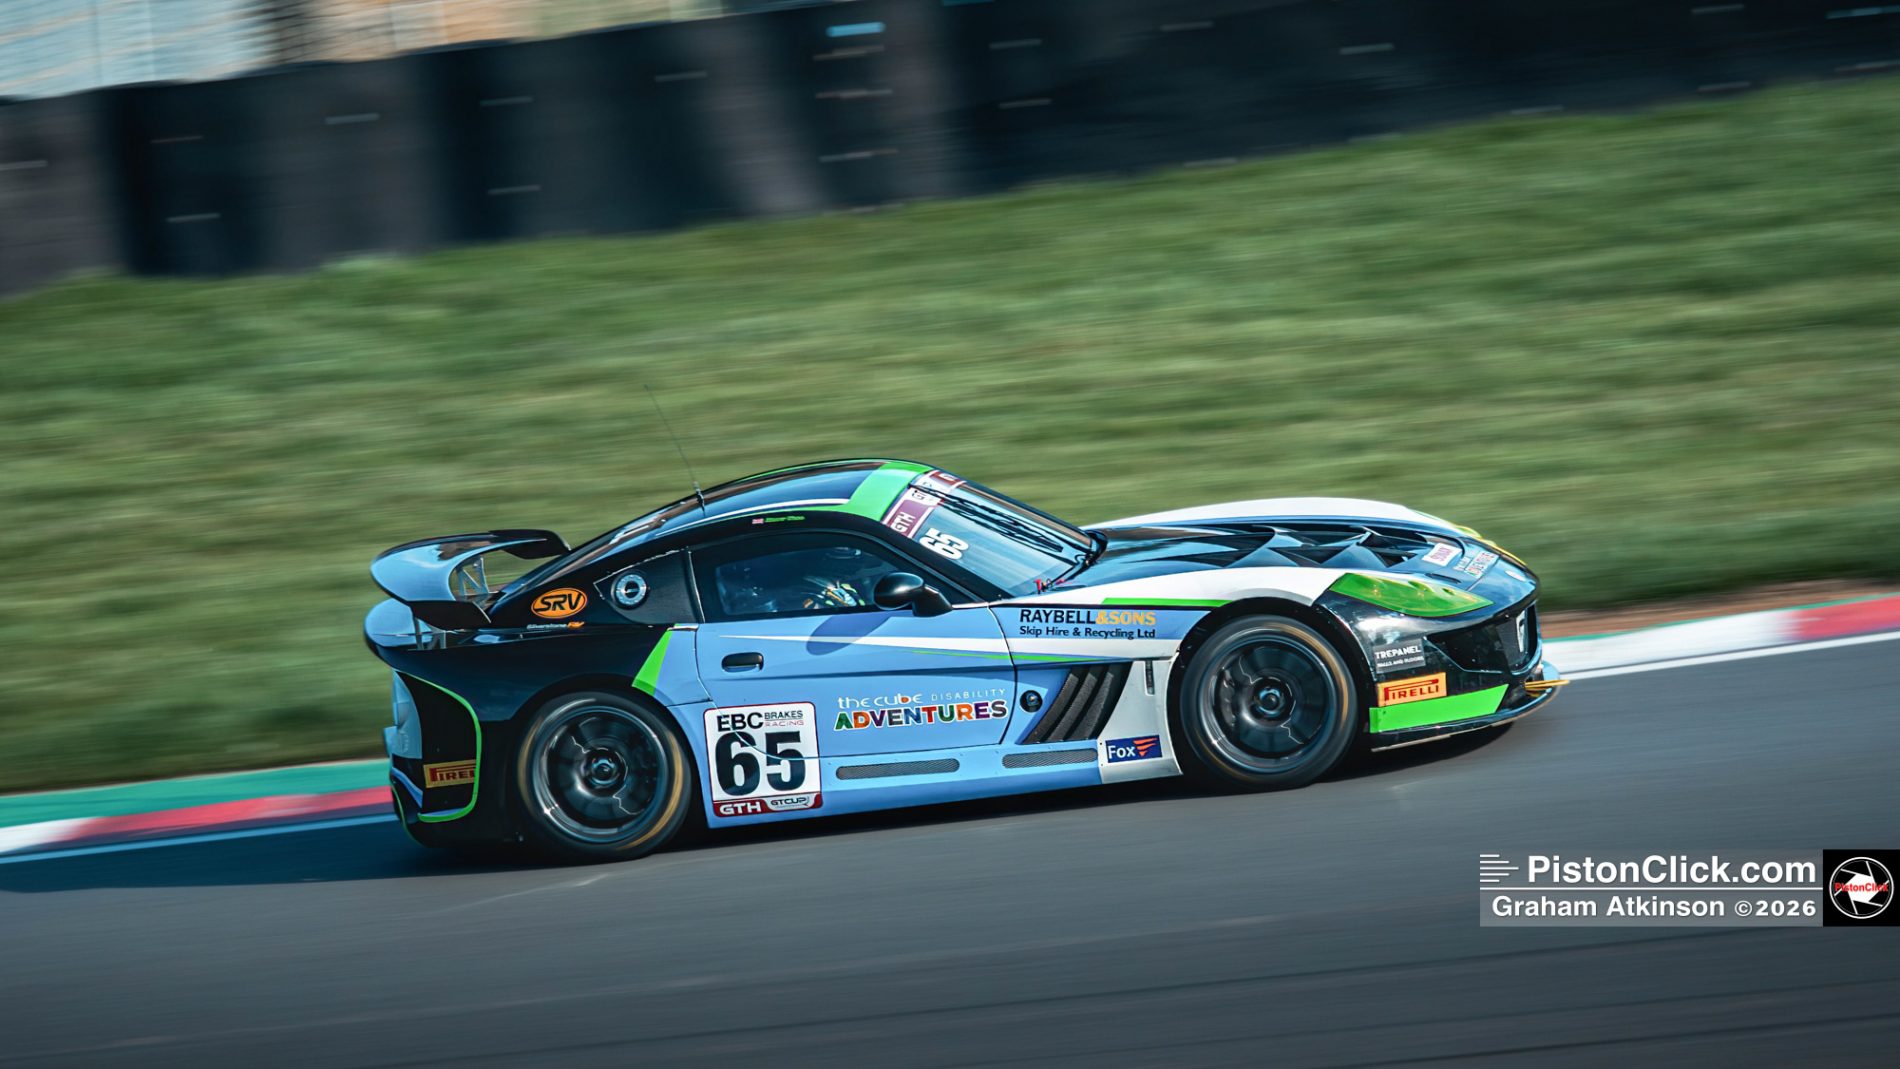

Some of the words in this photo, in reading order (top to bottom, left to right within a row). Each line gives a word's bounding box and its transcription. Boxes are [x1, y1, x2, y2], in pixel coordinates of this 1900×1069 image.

[890, 511, 917, 533] GTH
[919, 527, 969, 560] 65
[533, 593, 582, 613] SRV
[1019, 625, 1042, 638] Skip
[1046, 626, 1069, 637] Hire
[1072, 627, 1081, 636] &
[1084, 627, 1134, 639] Recycling
[1137, 628, 1156, 638] Ltd
[1374, 645, 1422, 660] TREPANEL
[838, 696, 869, 709] the
[873, 693, 923, 705] cube
[931, 688, 1006, 702] DISABILITY
[1384, 679, 1439, 701] PIRELLI
[717, 711, 764, 732] EBC
[764, 710, 804, 720] BRAKES
[834, 700, 1008, 731] ADVENTURES
[715, 730, 806, 796] 65
[1107, 745, 1136, 760] Fox
[719, 801, 762, 815] GTH
